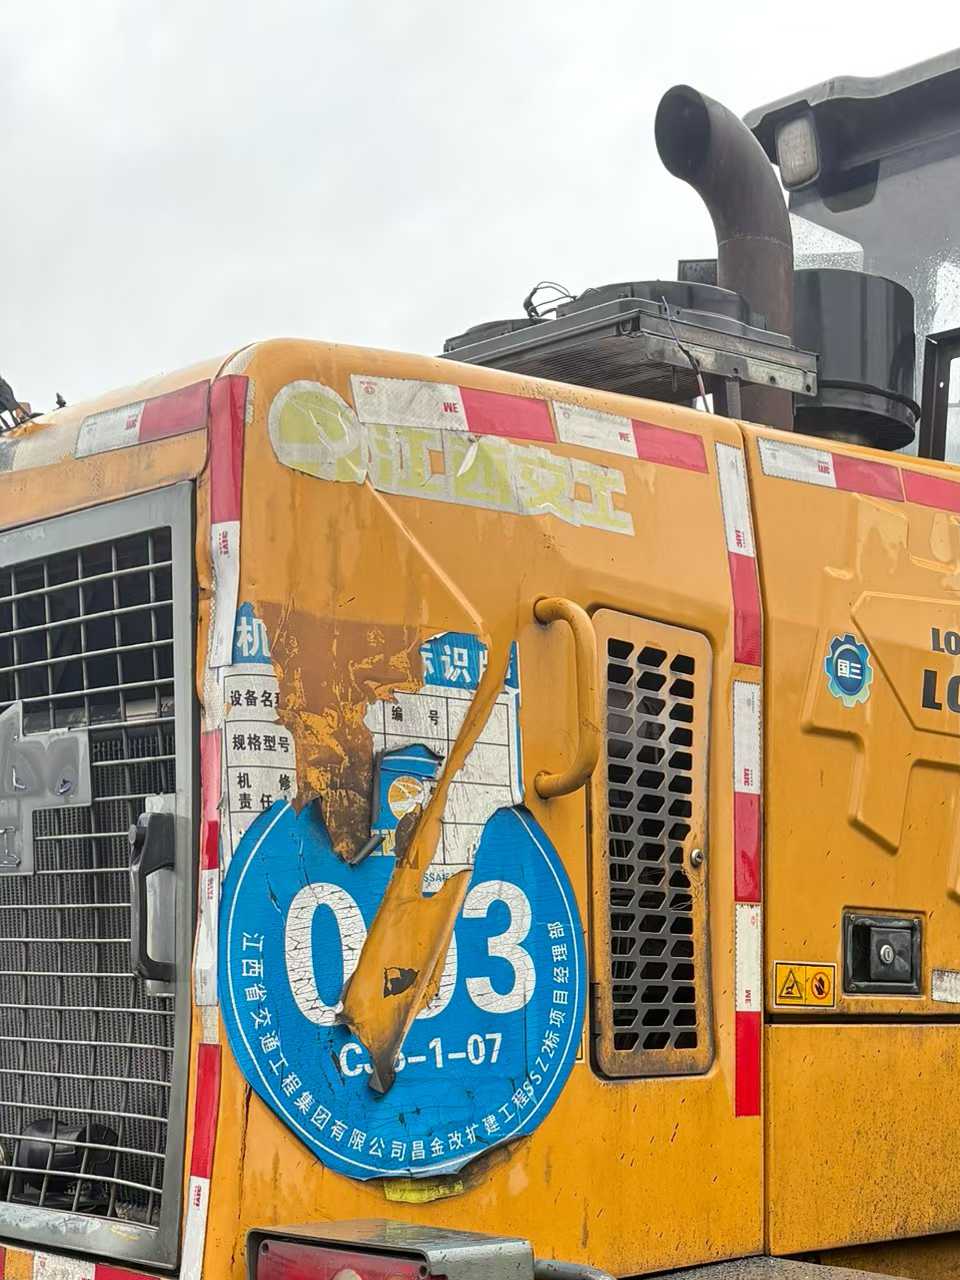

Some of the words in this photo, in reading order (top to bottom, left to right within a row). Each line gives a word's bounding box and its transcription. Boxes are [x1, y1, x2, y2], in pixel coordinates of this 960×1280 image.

[236, 615, 271, 657] 机
[231, 733, 291, 753] 规格型号
[238, 793, 289, 811] 责任
[339, 1032, 502, 1078] C-1-07
